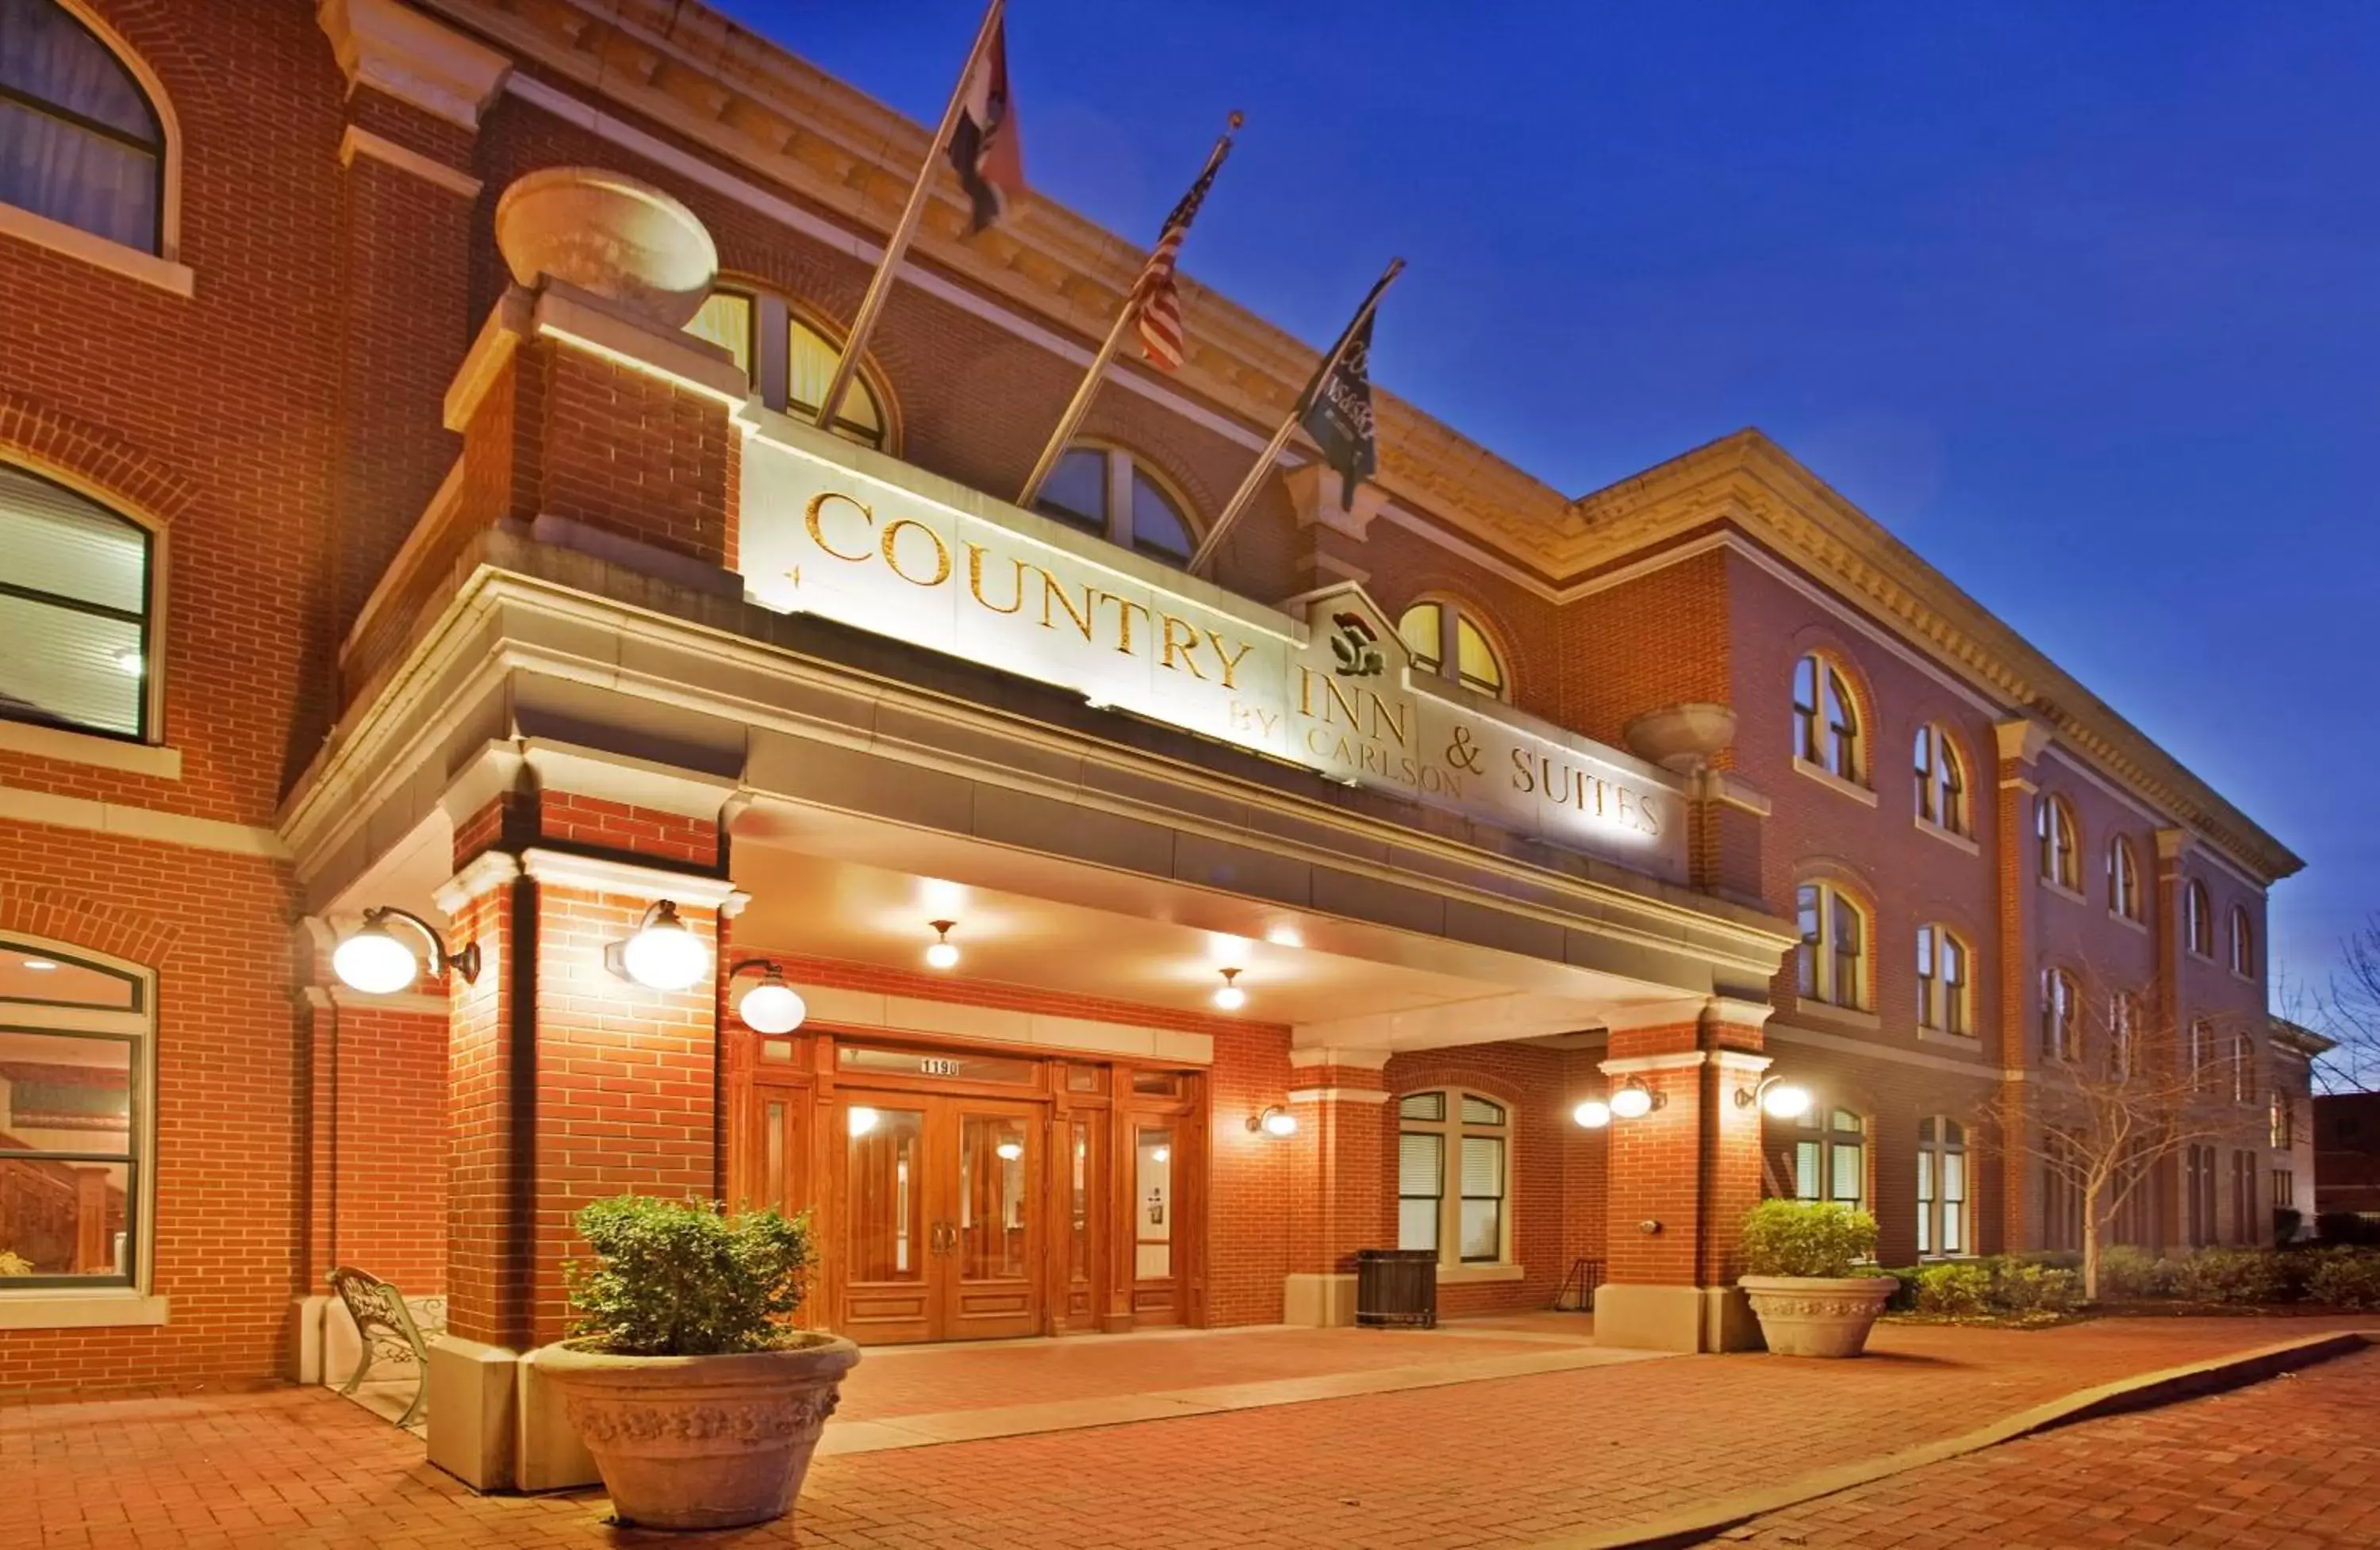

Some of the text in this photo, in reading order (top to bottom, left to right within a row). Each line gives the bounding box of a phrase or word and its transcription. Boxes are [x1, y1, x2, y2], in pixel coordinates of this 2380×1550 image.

[804, 491, 1661, 837] COUNTRY INN & SUITES
[1230, 699, 1462, 798] BY CARLSON
[923, 1059, 958, 1075] 1190
